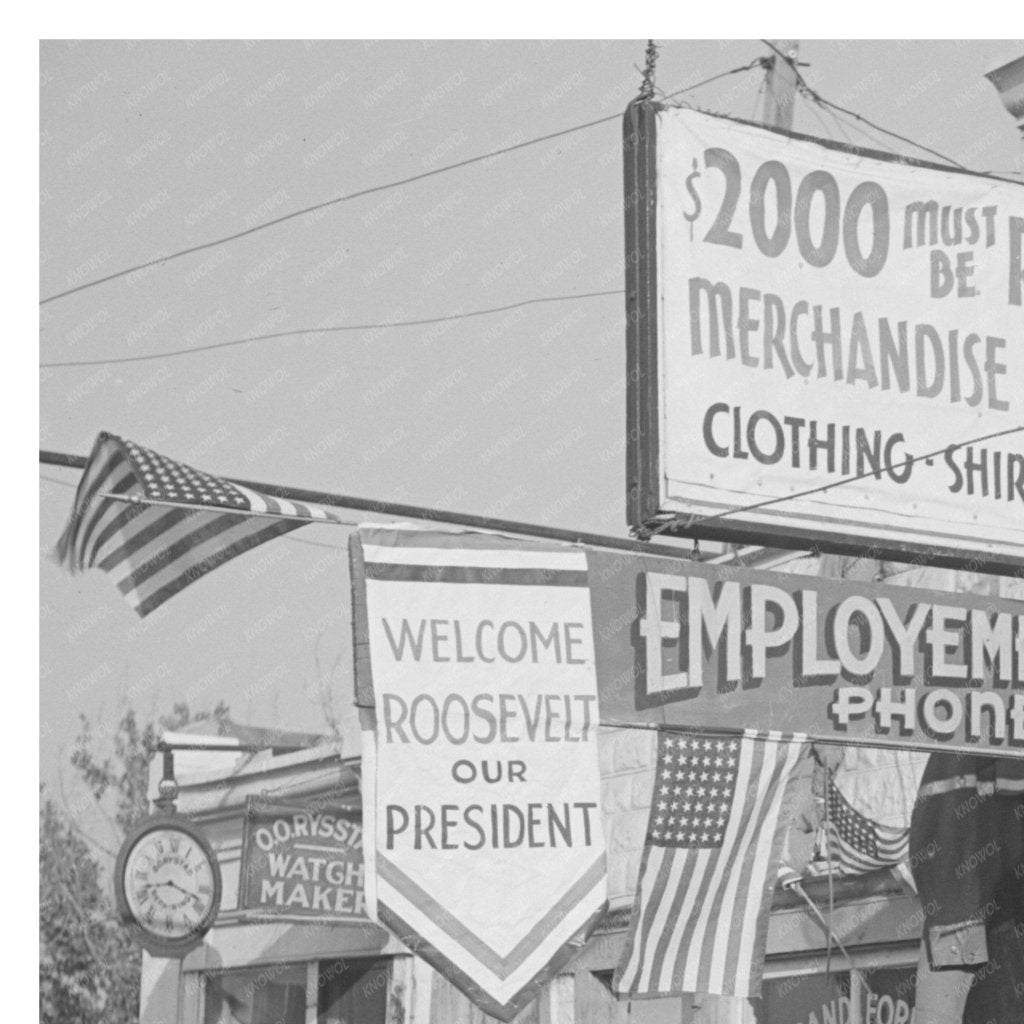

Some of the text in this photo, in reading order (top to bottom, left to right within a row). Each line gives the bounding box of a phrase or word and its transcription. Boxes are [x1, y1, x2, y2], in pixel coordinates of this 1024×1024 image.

[683, 147, 890, 278] $2000
[902, 199, 998, 250] MUST
[688, 276, 1010, 412] MERCHANDISE
[702, 402, 914, 484] CLOTHING
[382, 617, 588, 665] WELCOME
[382, 693, 597, 746] ROOSEVELT
[451, 759, 528, 784] OUR
[386, 802, 597, 850] PRESIDENT
